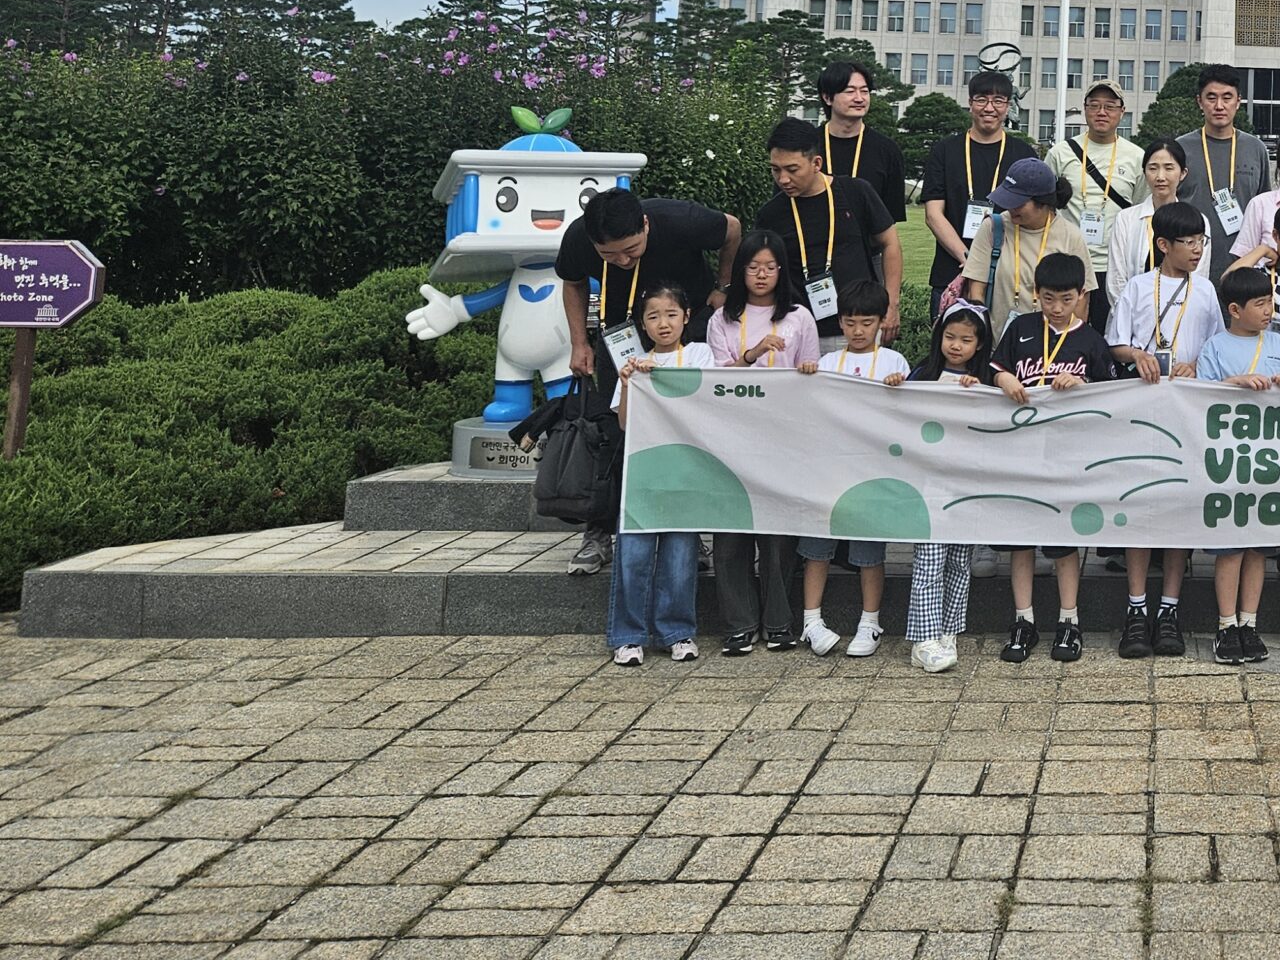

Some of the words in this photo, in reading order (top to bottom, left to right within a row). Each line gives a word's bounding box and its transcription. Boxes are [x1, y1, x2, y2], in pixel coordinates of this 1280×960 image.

[19, 256, 38, 271] 함께
[14, 273, 35, 289] 멋진
[0, 292, 24, 302] hoto
[28, 292, 54, 302] Zone
[1015, 356, 1087, 379] Natonals
[713, 383, 766, 398] S-OIL
[481, 441, 522, 452] 대한민국국
[498, 454, 530, 468] 희망이
